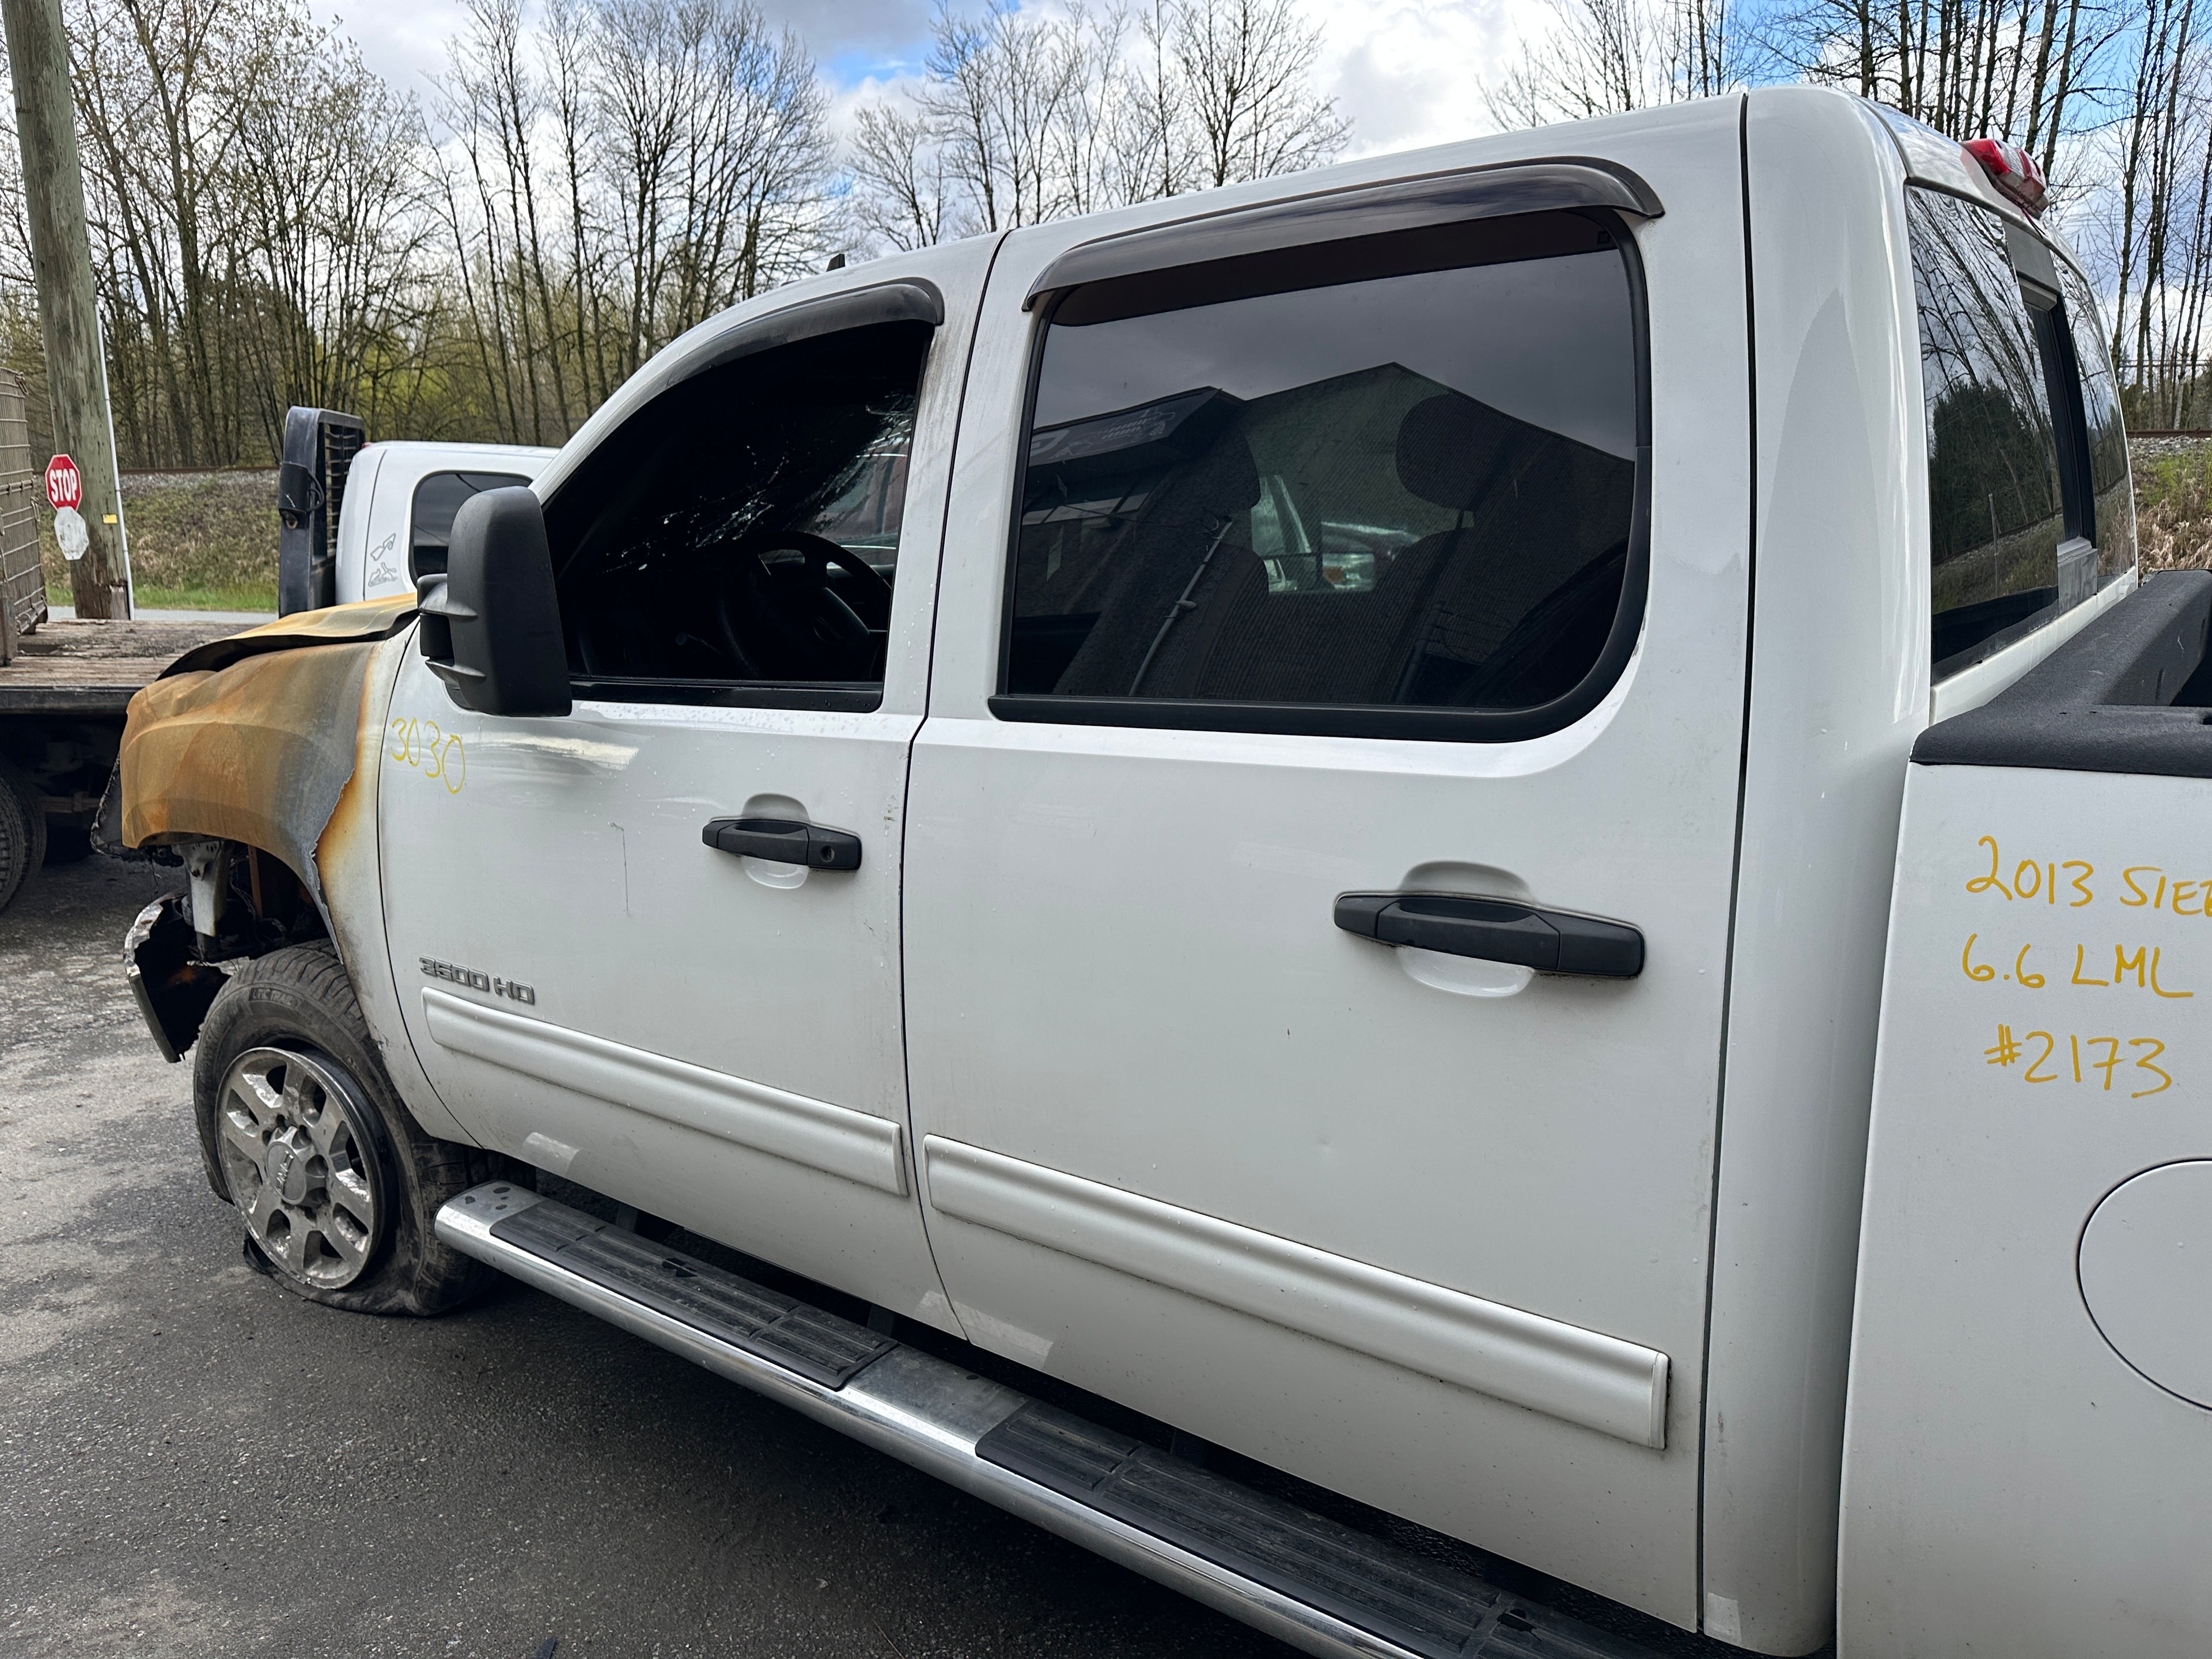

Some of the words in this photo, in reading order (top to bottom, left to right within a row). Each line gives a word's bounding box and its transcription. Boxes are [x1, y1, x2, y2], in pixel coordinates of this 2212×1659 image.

[49, 468, 77, 502] STOP
[391, 717, 465, 795] 3030
[1966, 835, 2094, 907] 2013
[419, 955, 489, 992] 3500
[493, 974, 535, 1005] HD
[1962, 933, 2046, 989] 6.6
[2071, 944, 2194, 999] LML
[1984, 1024, 2172, 1099] #2173
